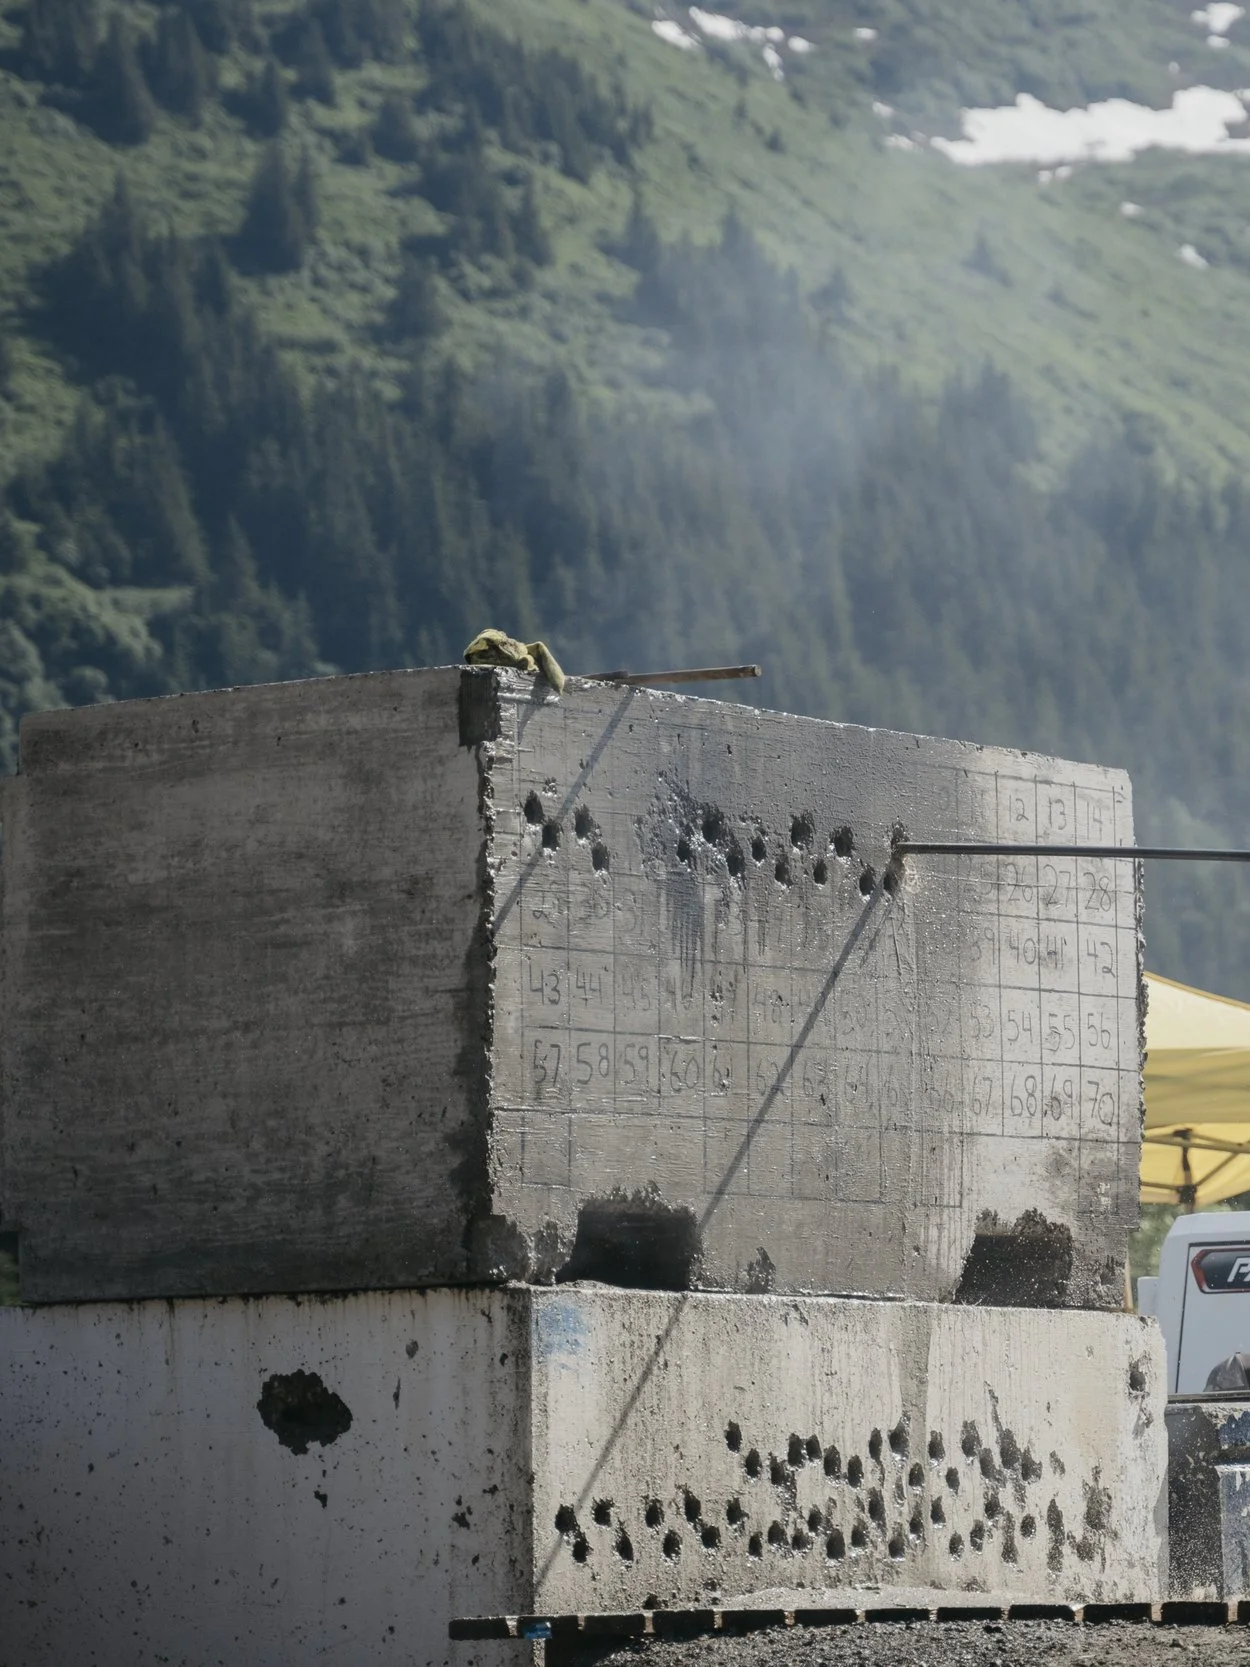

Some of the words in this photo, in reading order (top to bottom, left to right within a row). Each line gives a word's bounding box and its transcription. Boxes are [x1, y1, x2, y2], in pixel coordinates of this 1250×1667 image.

[1009, 794, 1029, 822] 12
[1049, 796, 1067, 831] 13
[1087, 801, 1104, 839] 14
[1006, 862, 1034, 903] 26
[1044, 864, 1072, 908] 27
[1083, 872, 1112, 912] 28
[1009, 929, 1038, 965] 40
[1046, 935, 1068, 970] 41
[1086, 938, 1116, 978] 42
[529, 964, 561, 1006] 43
[575, 967, 603, 1007] 44
[971, 1004, 994, 1038] 53
[1007, 1010, 1033, 1043] 54
[1045, 1013, 1075, 1051] 55
[1087, 1012, 1111, 1049] 56
[533, 1040, 561, 1087] 57
[577, 1042, 610, 1085] 58
[620, 1043, 650, 1086] 59
[670, 1051, 701, 1093] 60
[971, 1075, 993, 1116] 67
[1010, 1074, 1037, 1117] 68
[1050, 1074, 1073, 1121] 69
[1087, 1080, 1115, 1126] 70
